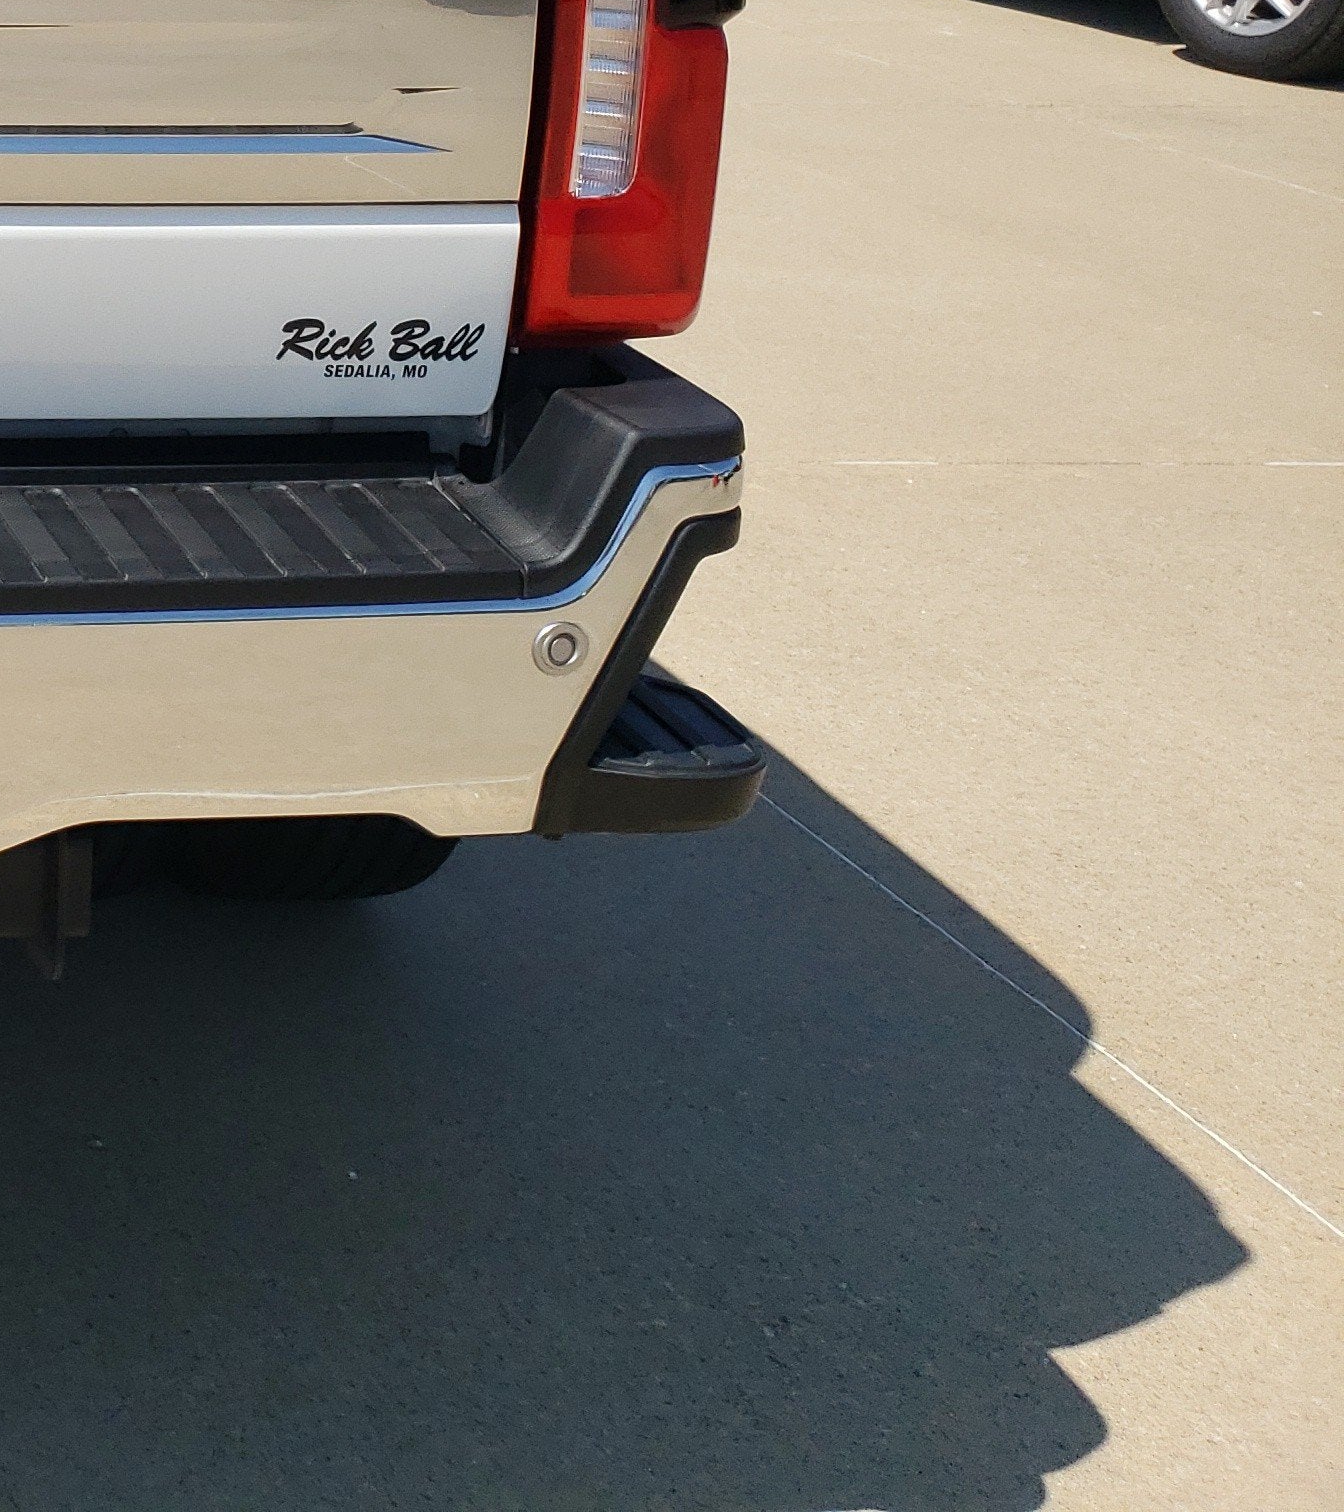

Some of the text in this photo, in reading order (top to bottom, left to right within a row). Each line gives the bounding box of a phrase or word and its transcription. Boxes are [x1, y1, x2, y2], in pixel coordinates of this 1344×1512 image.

[276, 318, 486, 361] Rick Ball
[323, 364, 428, 380] SEDALIA, MO
